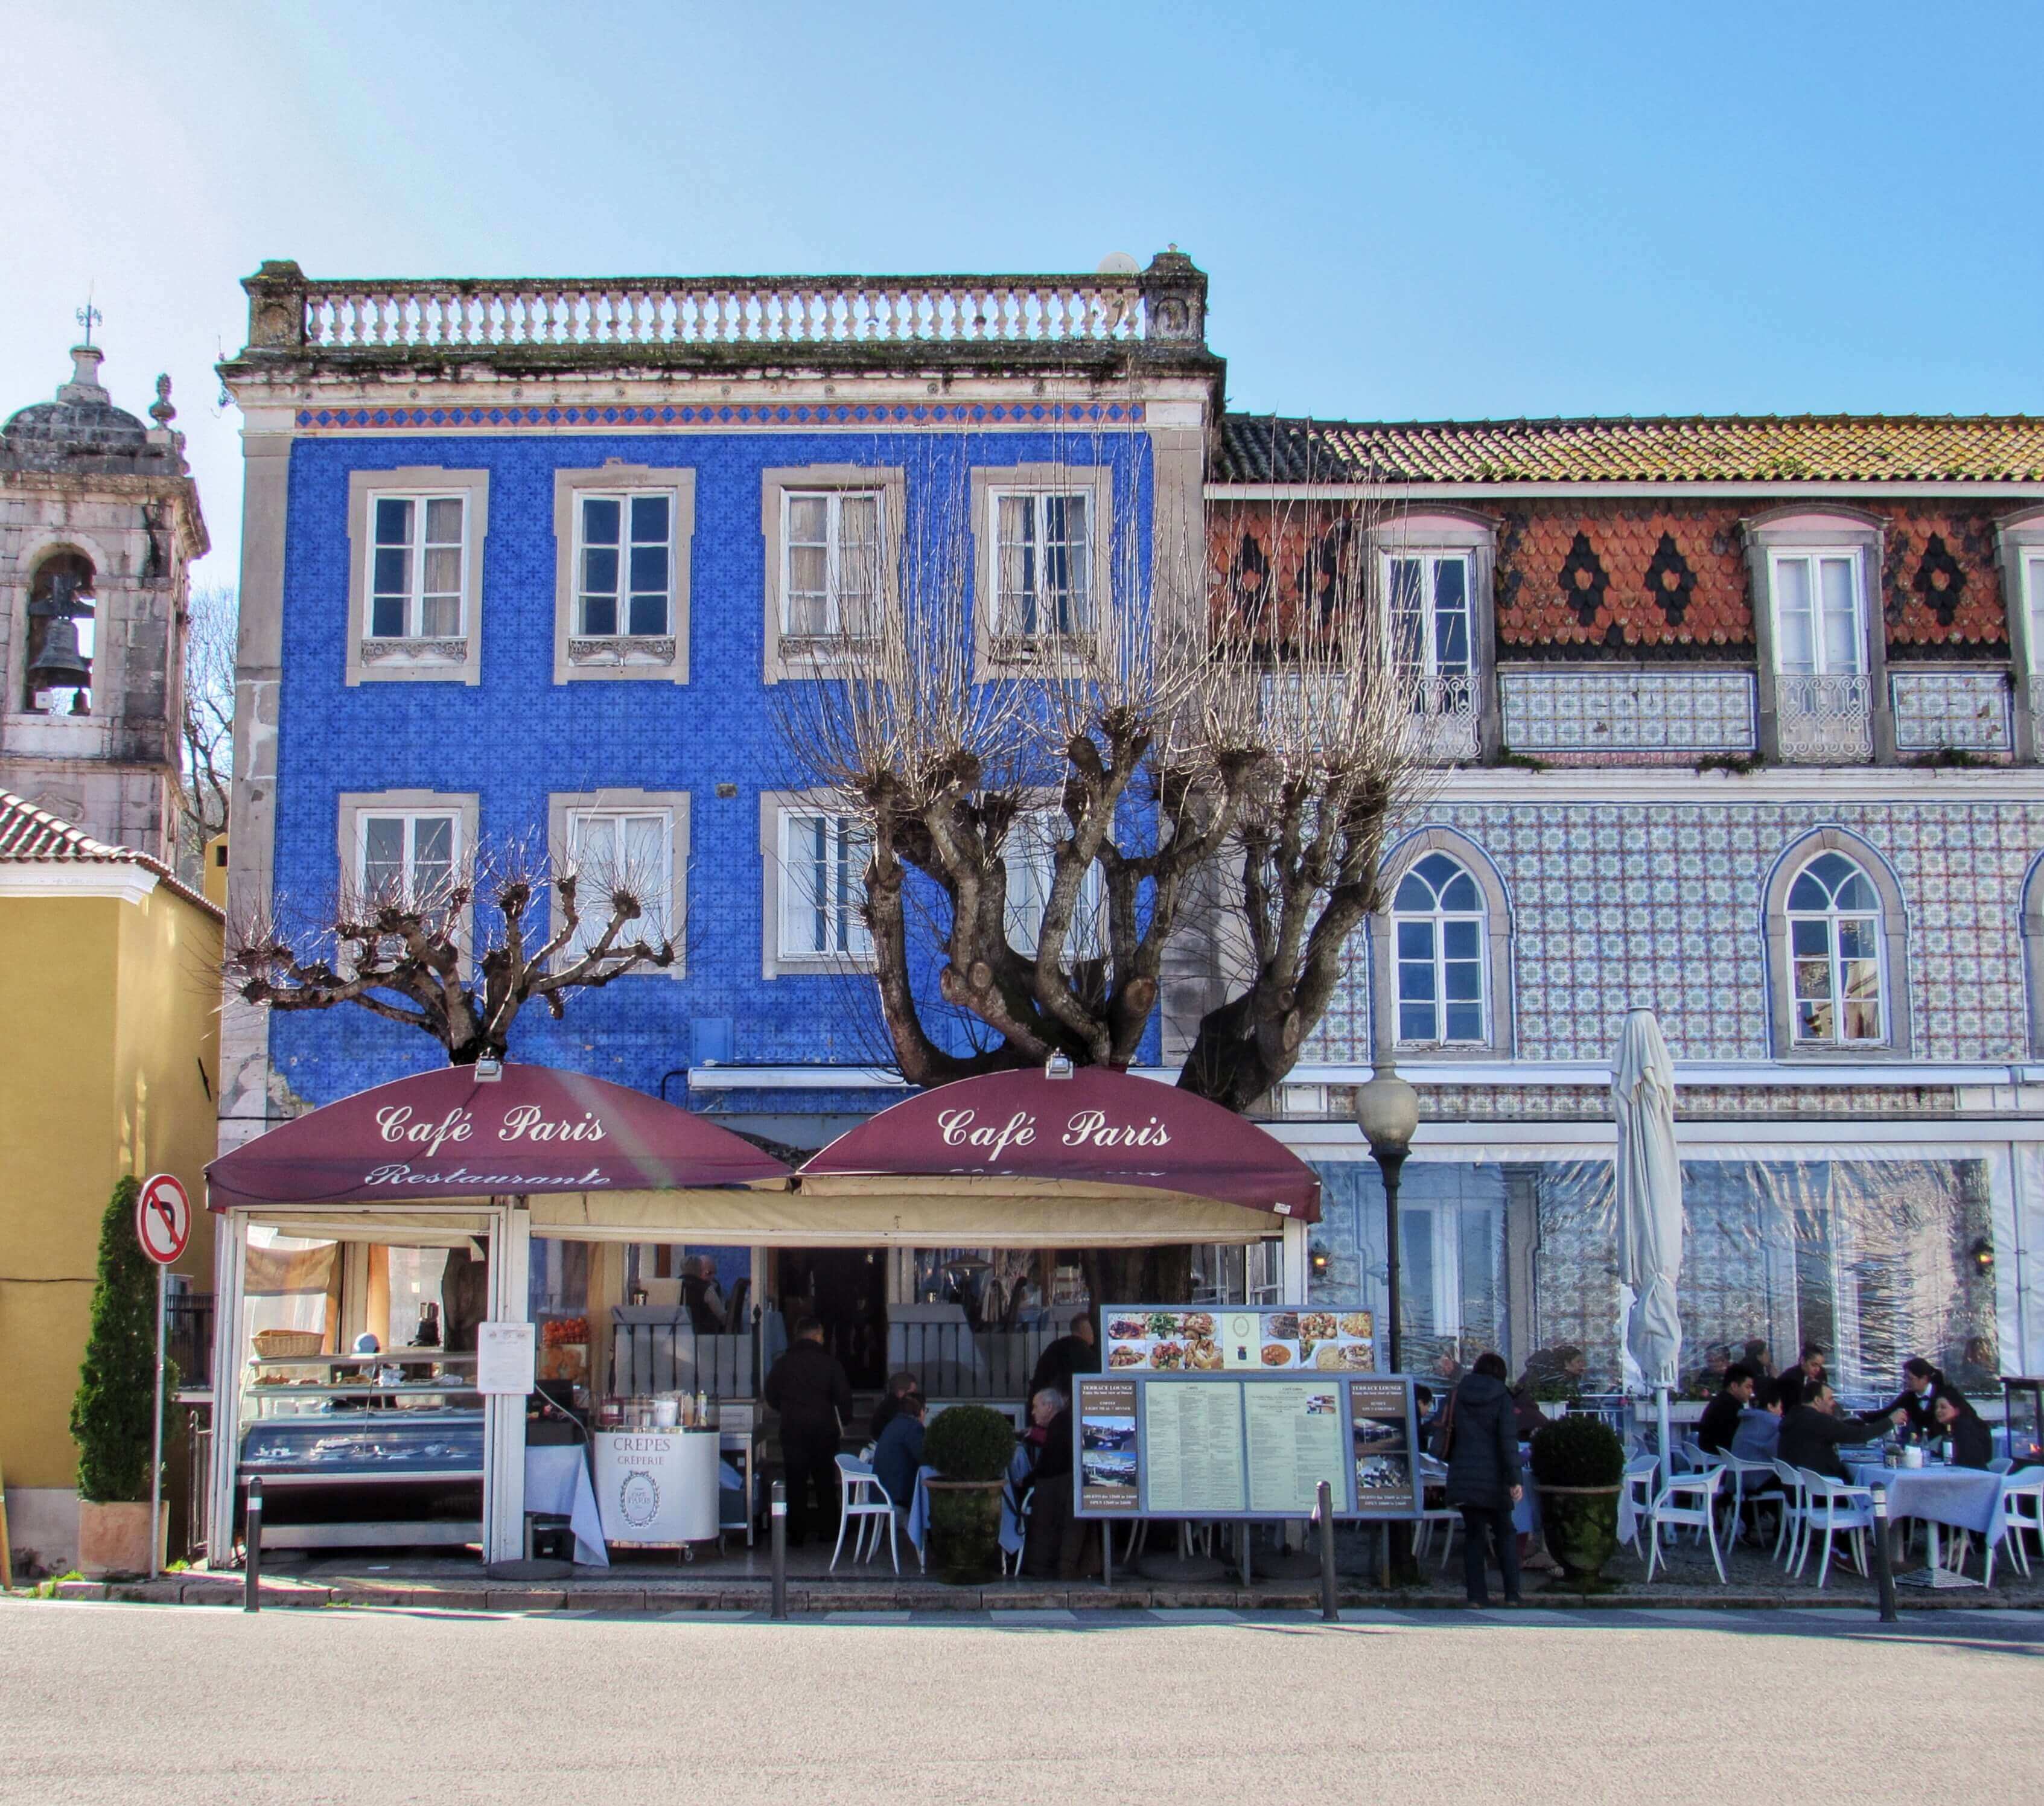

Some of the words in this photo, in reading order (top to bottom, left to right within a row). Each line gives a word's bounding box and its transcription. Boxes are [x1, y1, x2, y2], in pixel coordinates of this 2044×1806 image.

[376, 1106, 473, 1157] Café
[498, 1105, 608, 1142] Paris
[937, 1109, 1037, 1162] Café
[1062, 1110, 1172, 1146] Paris
[614, 1438, 670, 1452] CREPES
